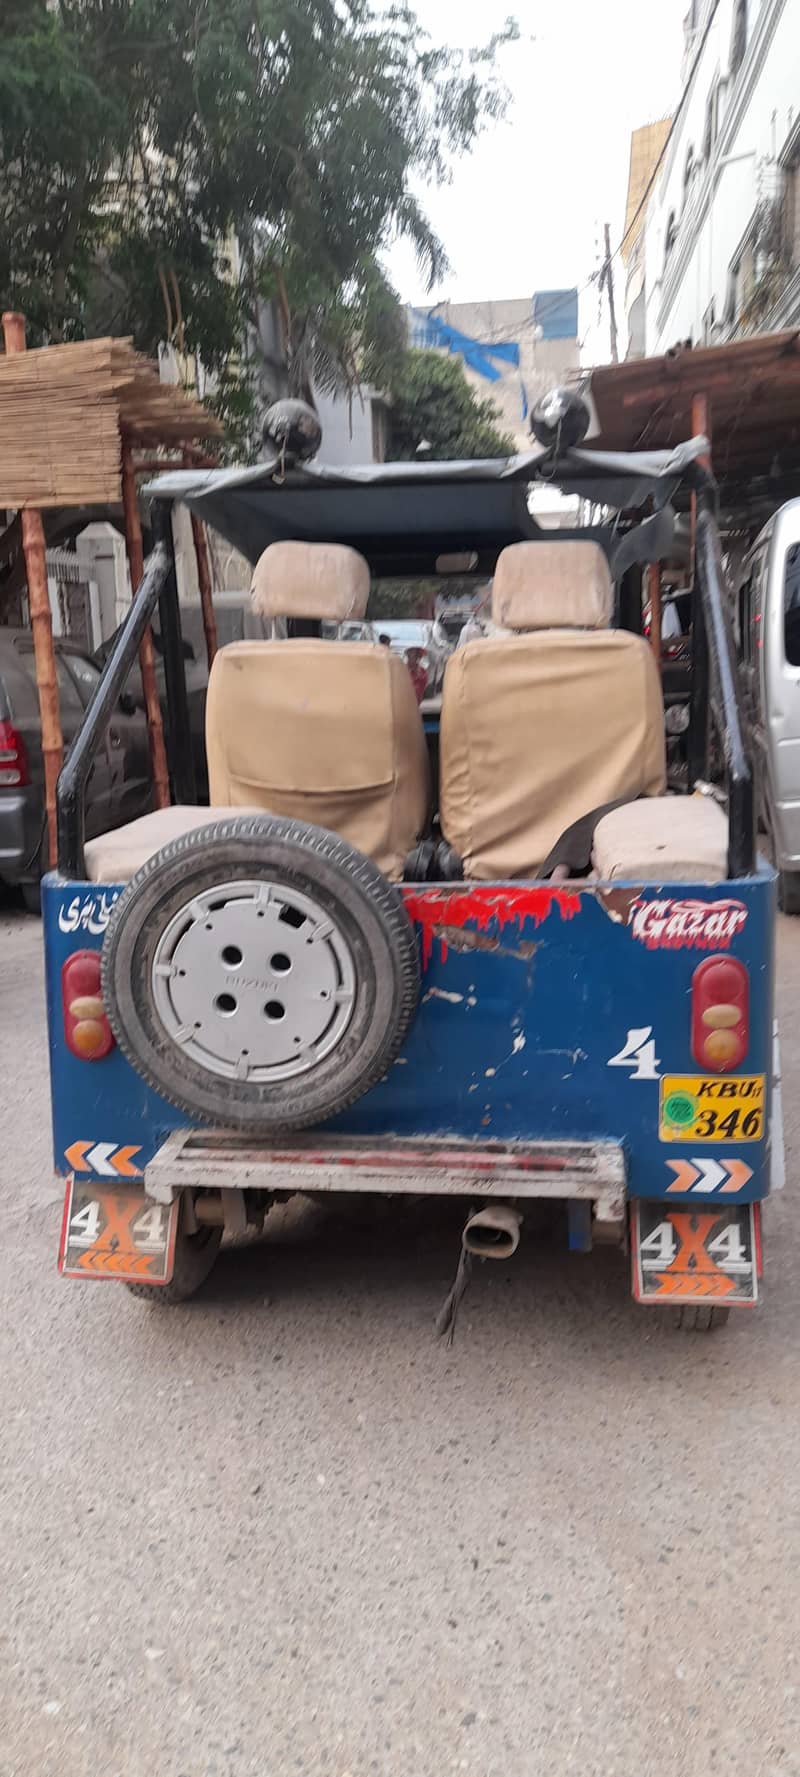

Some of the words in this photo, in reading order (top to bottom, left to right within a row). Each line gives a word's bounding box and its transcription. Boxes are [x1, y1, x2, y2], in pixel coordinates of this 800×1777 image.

[632, 898, 748, 940] Gazar
[607, 1026, 662, 1079] 4
[696, 1080, 756, 1098] KBU
[695, 1108, 762, 1138] 346
